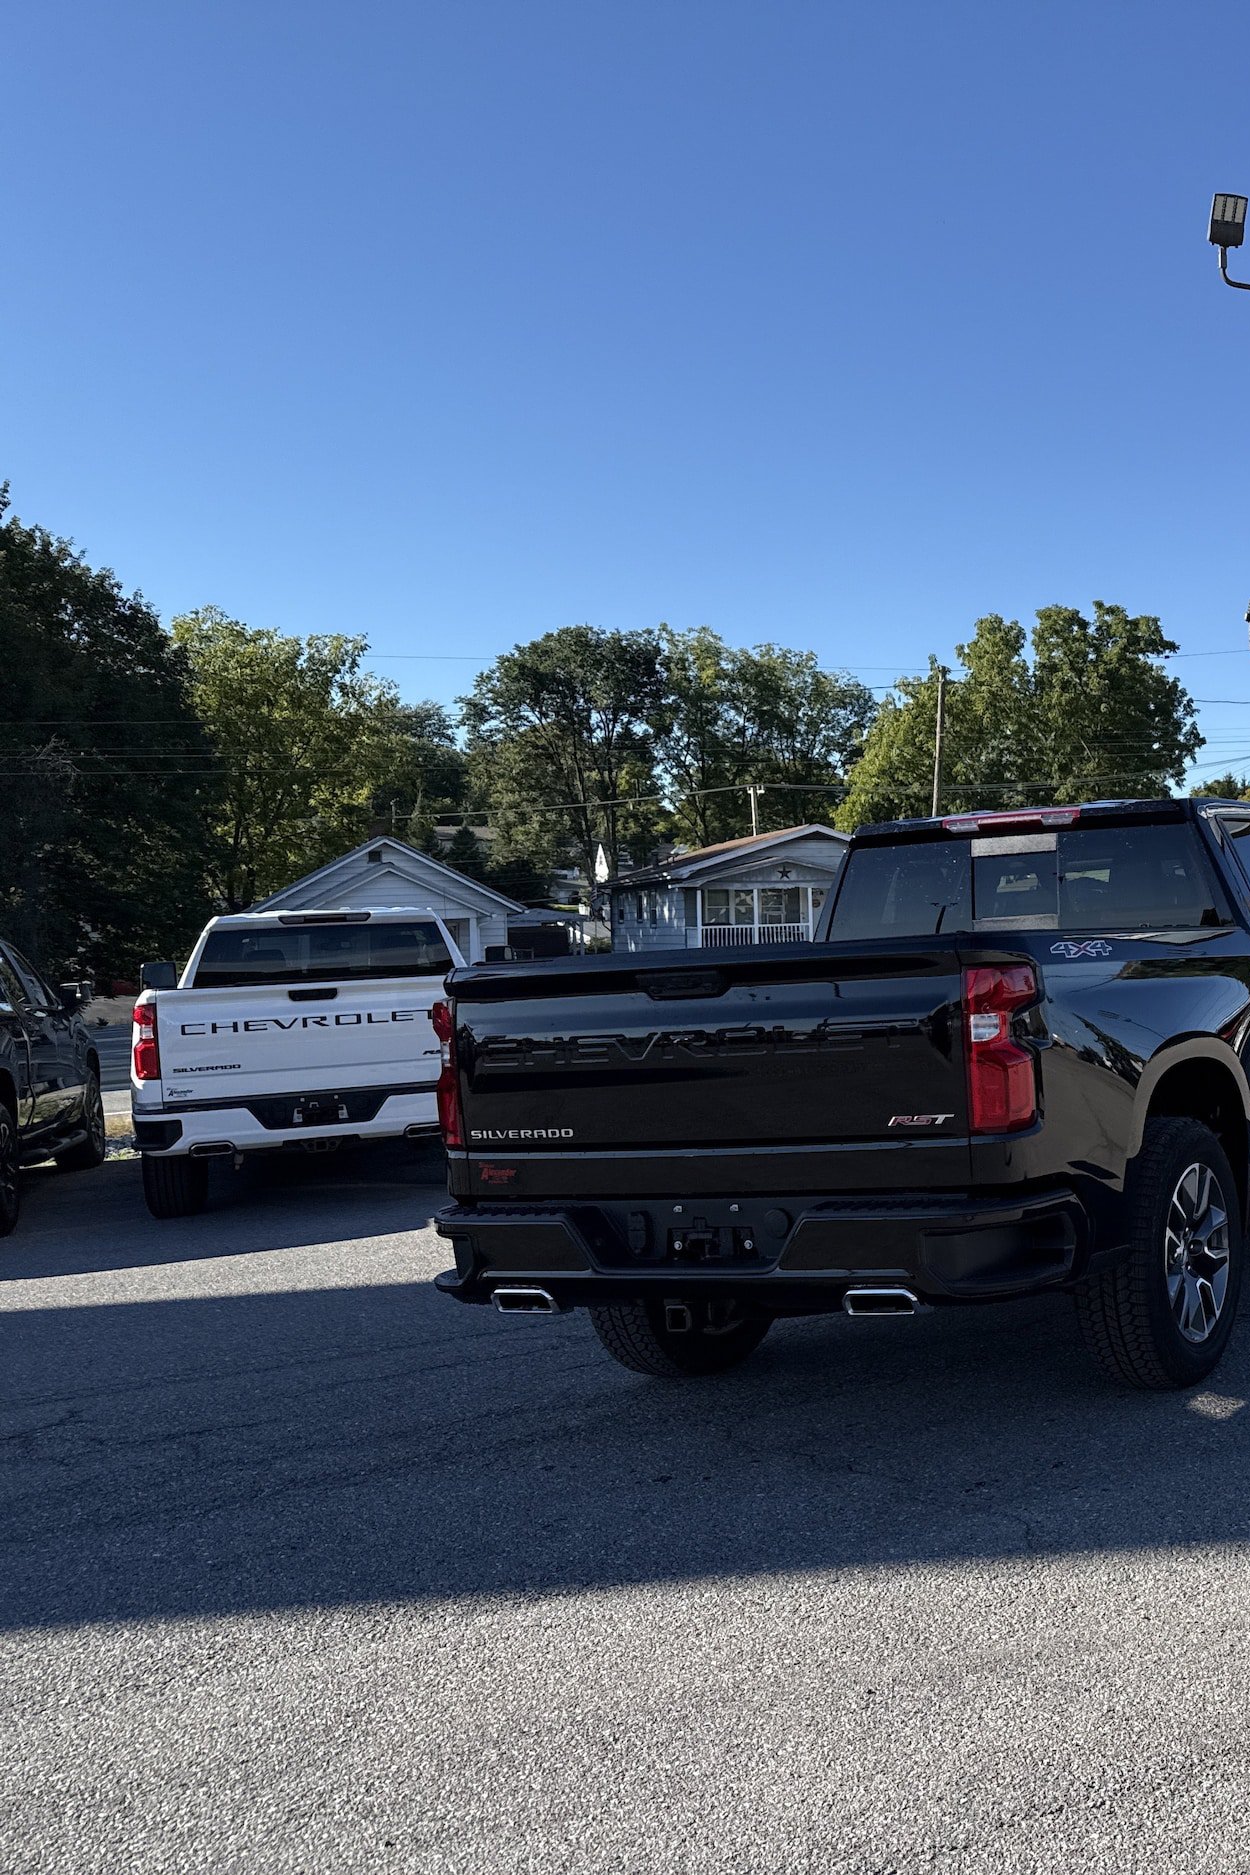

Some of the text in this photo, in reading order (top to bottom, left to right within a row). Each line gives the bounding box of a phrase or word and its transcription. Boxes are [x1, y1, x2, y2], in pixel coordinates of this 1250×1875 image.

[180, 1009, 434, 1036] CHEVROLET
[172, 1064, 241, 1073] SILVERADO
[887, 1114, 955, 1126] RST
[470, 1128, 574, 1139] SILVERADO
